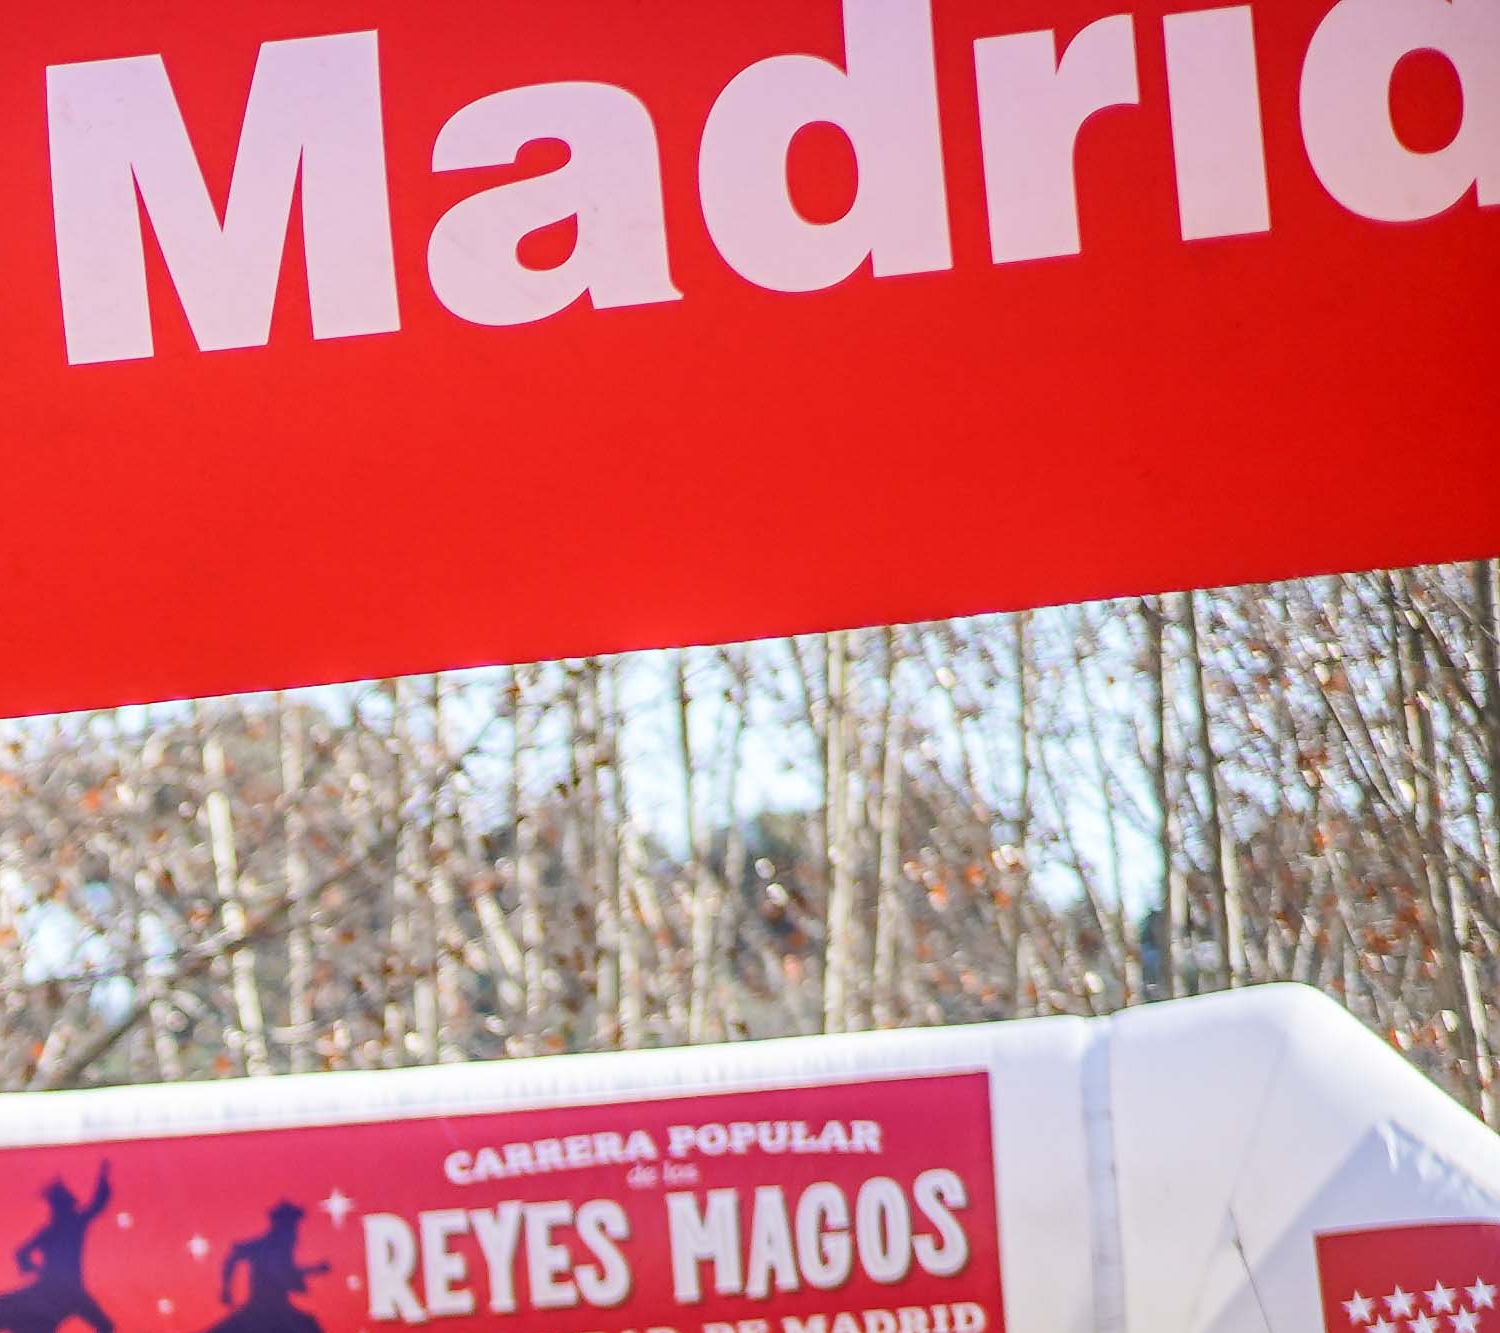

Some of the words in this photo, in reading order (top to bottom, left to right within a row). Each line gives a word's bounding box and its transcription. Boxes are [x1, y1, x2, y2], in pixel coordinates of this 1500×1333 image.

[444, 1130, 657, 1186] CARRERA
[667, 1120, 882, 1158] POPULAR
[627, 1160, 657, 1189] de
[363, 1199, 631, 1323] REYES
[666, 1167, 969, 1302] MAGOS
